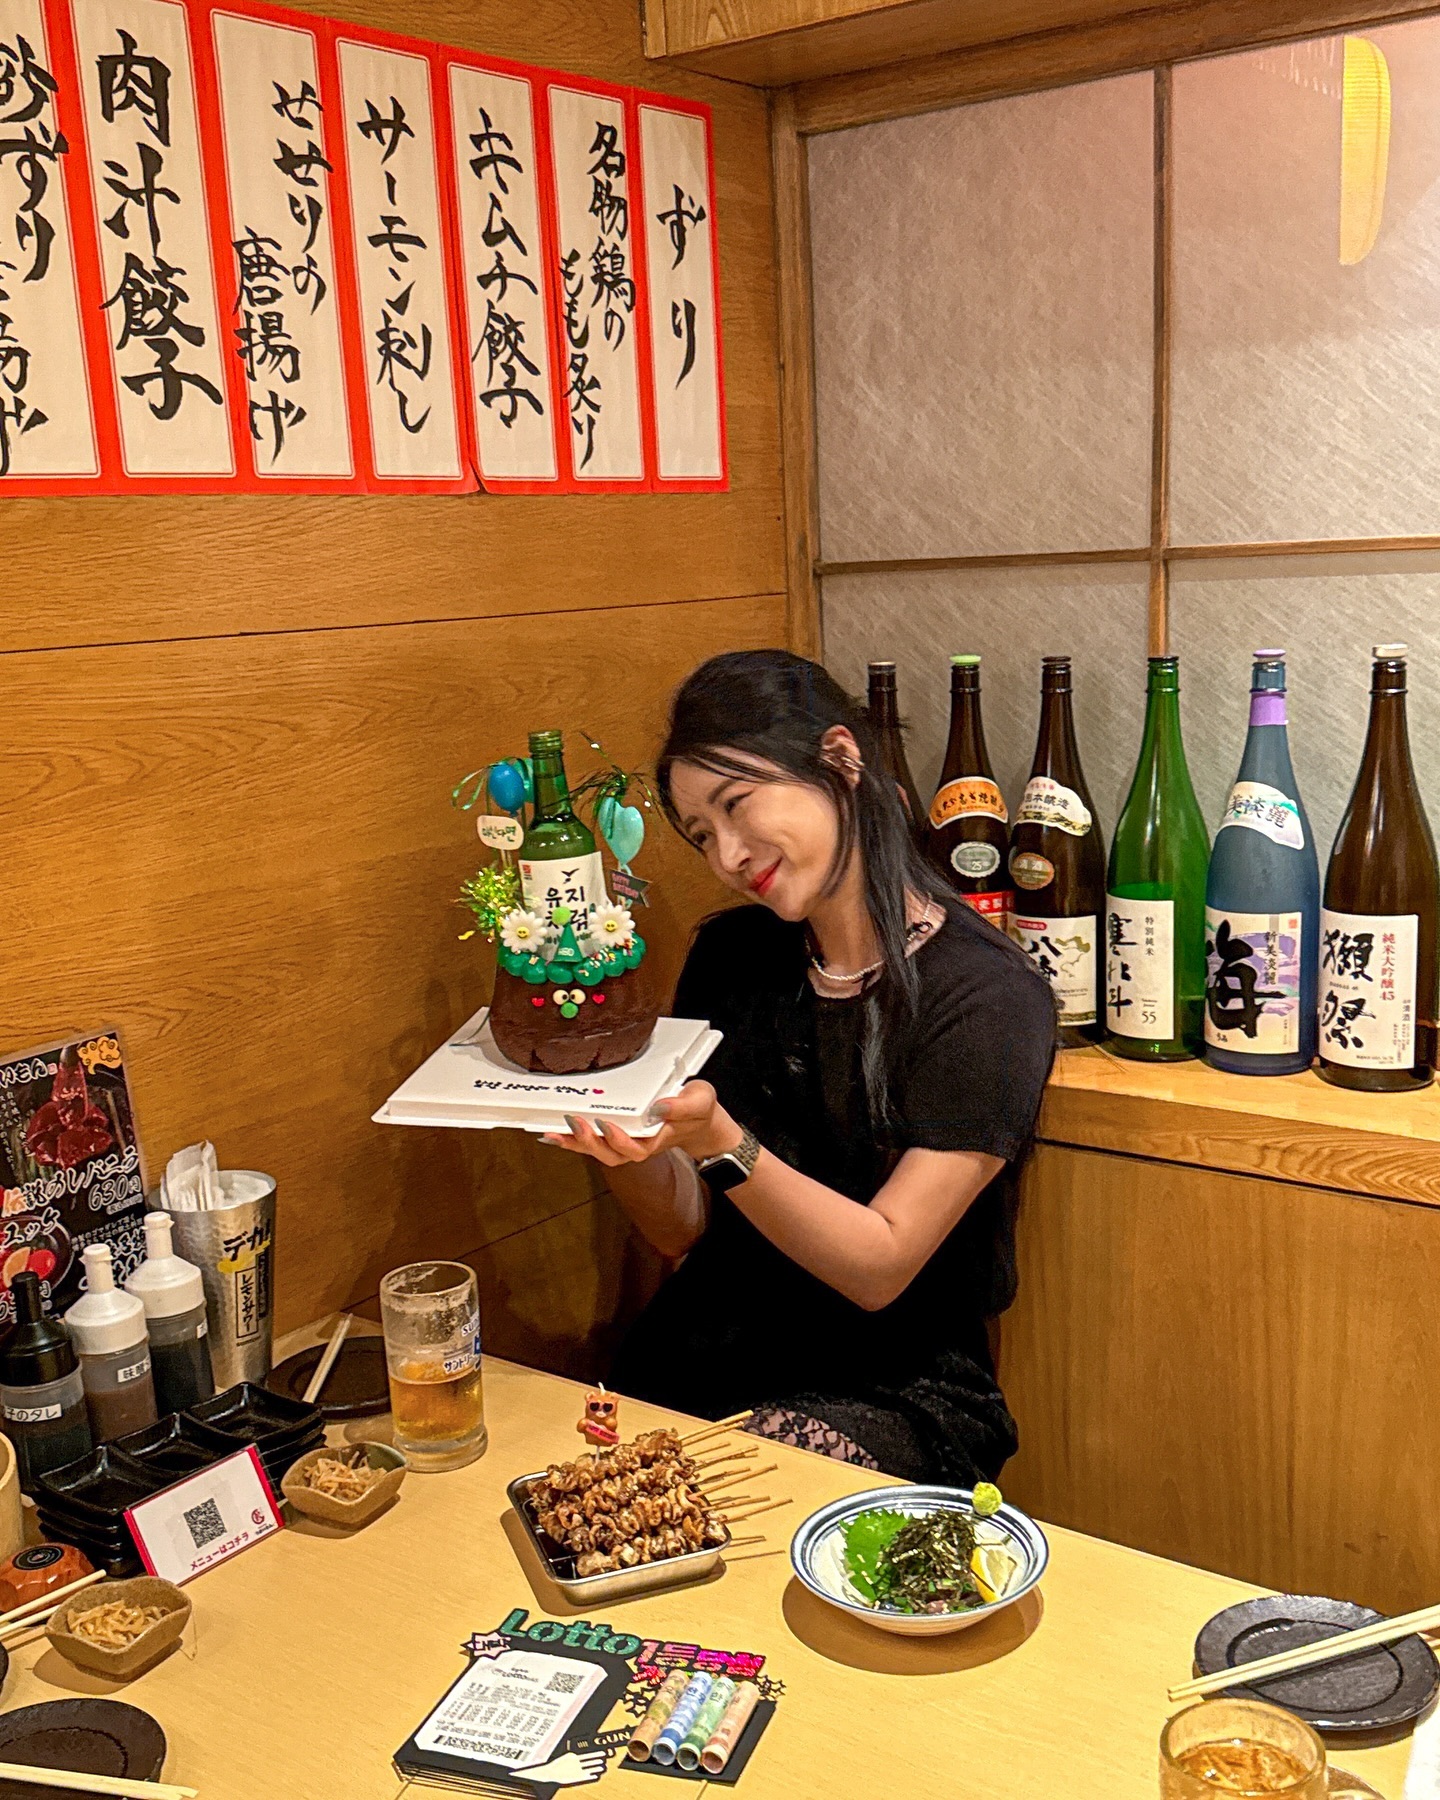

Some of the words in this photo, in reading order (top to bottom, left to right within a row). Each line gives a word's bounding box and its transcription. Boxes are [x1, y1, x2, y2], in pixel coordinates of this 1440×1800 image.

[96, 29, 224, 420] 肉汁餃子
[273, 81, 333, 316] せせりの
[587, 121, 636, 352] 名物鶏の
[357, 96, 431, 433] サーモン刺し
[469, 107, 544, 428] キムチ餃子
[656, 184, 705, 390] ずり
[232, 226, 306, 466] 唐揚げ
[557, 248, 601, 470] もも炙り
[545, 885, 585, 908] 유지
[1144, 916, 1155, 956] 特別純米
[1107, 912, 1138, 1018] 寒北斗
[1141, 1011, 1157, 1025] 55
[1204, 919, 1287, 1039] 海
[88, 1174, 142, 1212] 630円
[240, 1273, 255, 1332] レモンサワー
[190, 1531, 250, 1571] メニューはコチラ
[499, 1608, 642, 1655] Lotto
[593, 1730, 631, 1746] GUN
